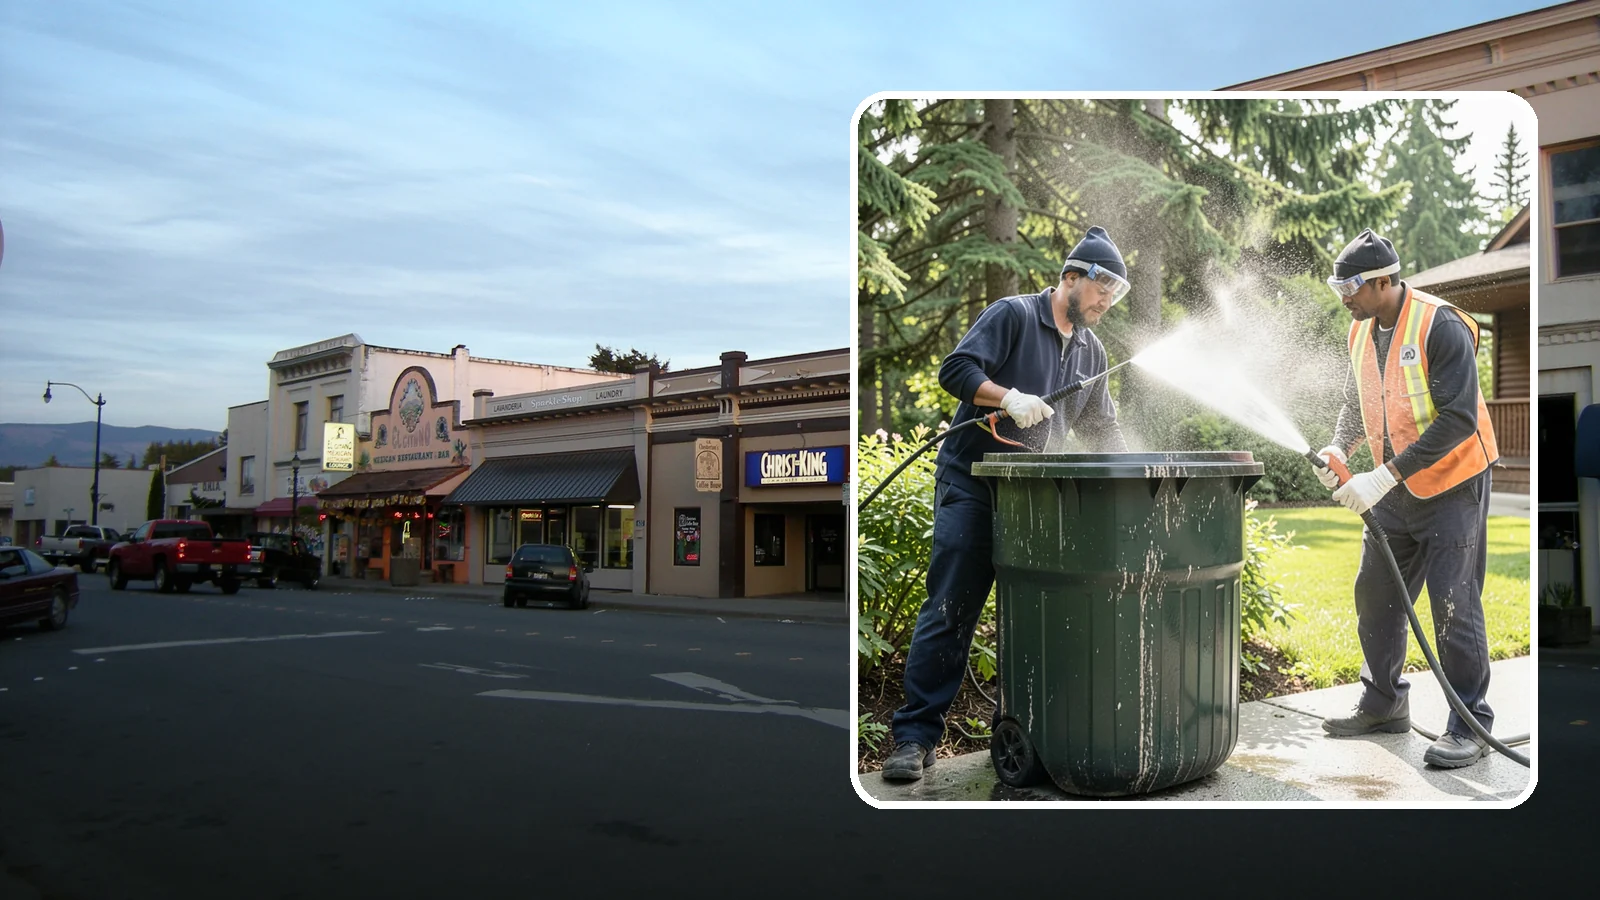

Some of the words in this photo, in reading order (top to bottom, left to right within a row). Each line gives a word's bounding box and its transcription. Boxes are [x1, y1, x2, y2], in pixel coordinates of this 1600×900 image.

[596, 389, 623, 400] LAUNDRY
[494, 402, 522, 412] LAVANDERIA
[531, 398, 561, 409] Sparkle
[562, 394, 582, 404] Shop
[374, 455, 395, 463] MEXICAN
[397, 452, 433, 462] RESTAURANT
[438, 450, 450, 459] BAR
